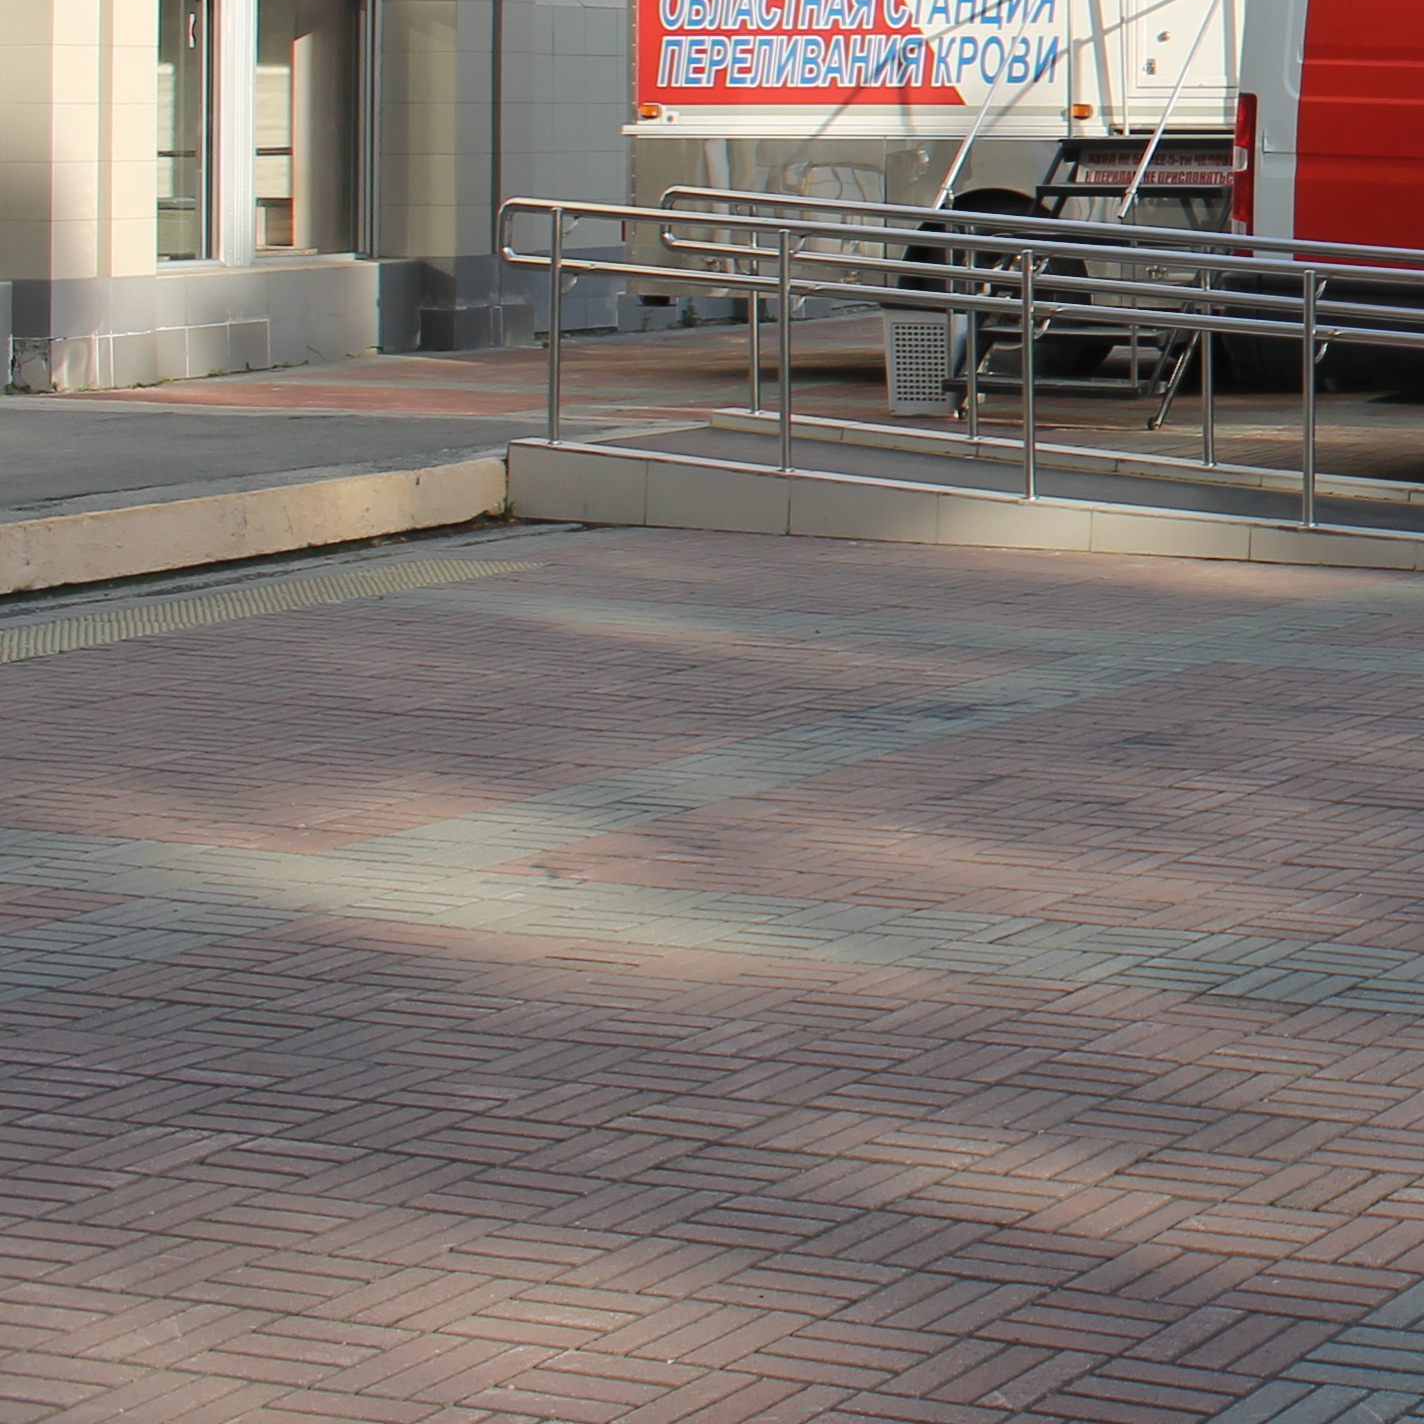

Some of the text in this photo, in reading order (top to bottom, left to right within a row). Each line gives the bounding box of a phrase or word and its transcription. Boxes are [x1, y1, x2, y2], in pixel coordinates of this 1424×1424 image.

[656, 35, 1061, 88] ПЕРЕЛИВАНИЯ КРОВИ
[1095, 170, 1136, 184] ПЕРИЛА
[1159, 171, 1234, 184] ПРИСЛОНЯТЬС
